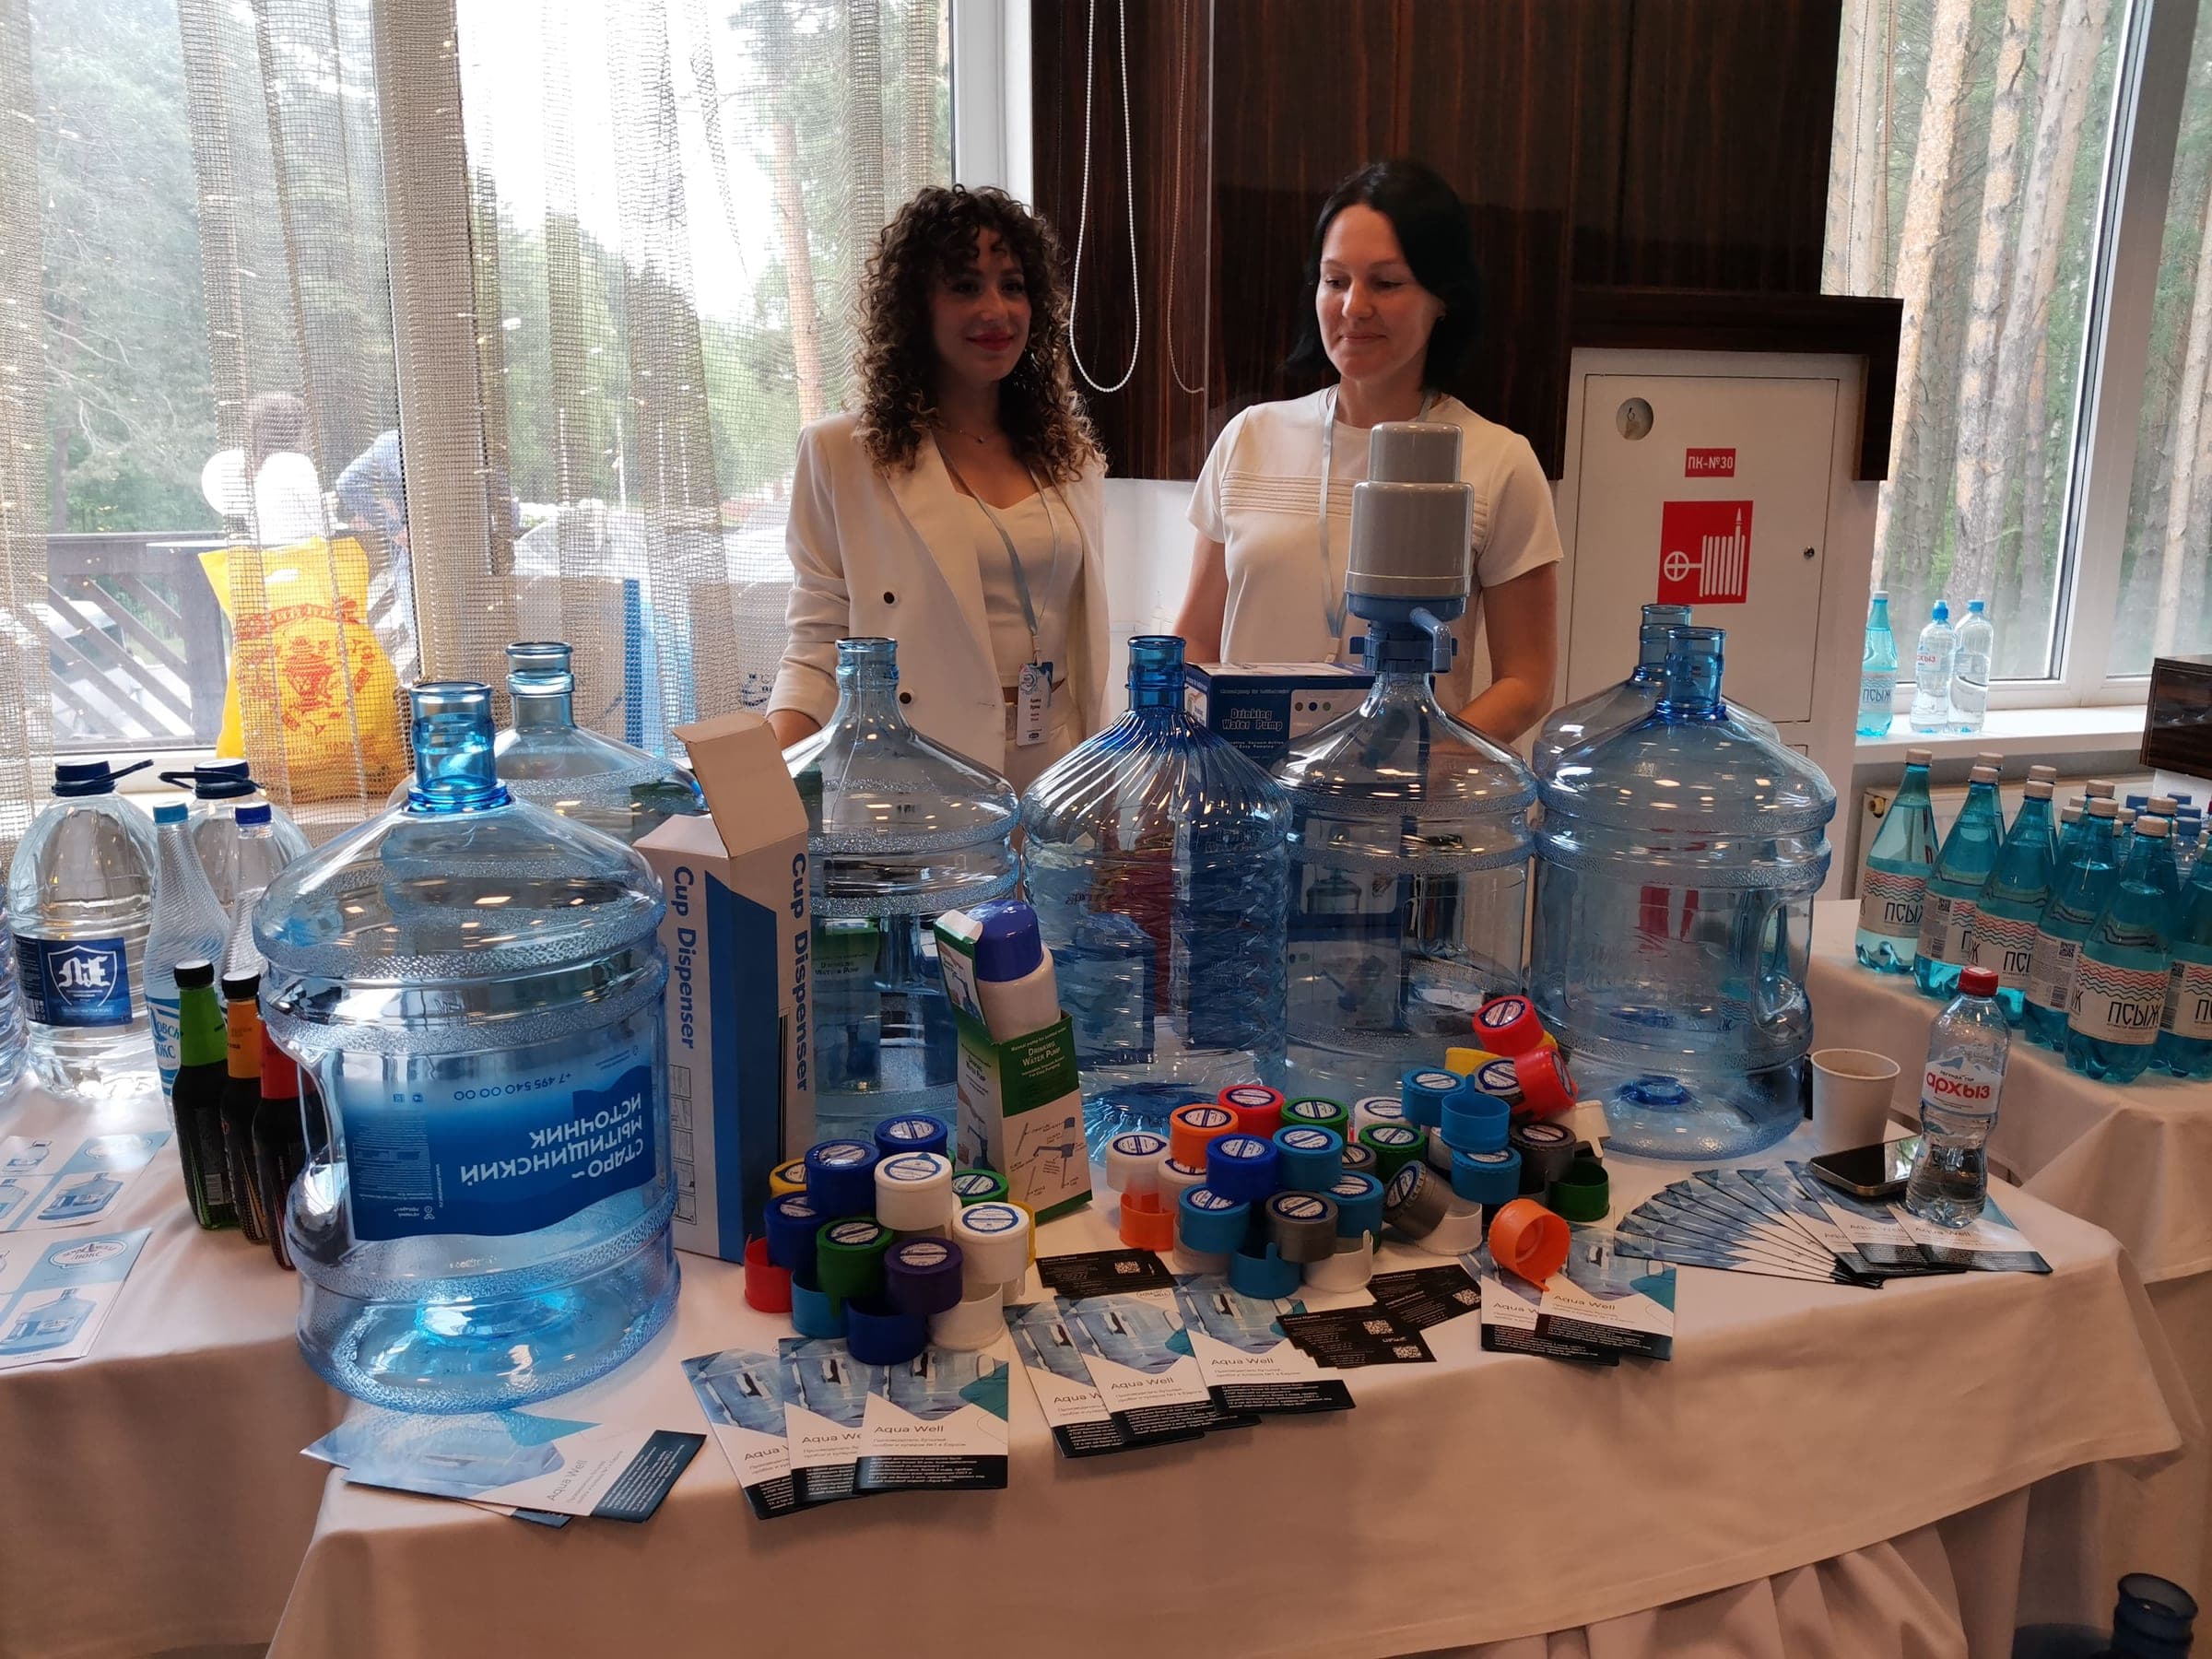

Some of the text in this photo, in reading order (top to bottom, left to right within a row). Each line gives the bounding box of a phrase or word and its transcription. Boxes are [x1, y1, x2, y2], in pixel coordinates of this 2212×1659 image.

[1688, 455, 1734, 470] ПК-№30
[1230, 708, 1273, 721] Drinking
[1222, 720, 1283, 731] Water Pump
[671, 865, 696, 1049] Cup Dispenser
[2004, 951, 2031, 973] ПС
[791, 853, 807, 1090] Cup Dispenser
[2107, 1001, 2161, 1027] ПСЫЖ
[534, 1075, 557, 1088] 495
[529, 1093, 641, 1149] ИСТОЧНИК
[460, 1115, 642, 1186] МЫТИЩИНСКИЙ
[1553, 1295, 1615, 1311] Aqua Well
[1211, 1357, 1243, 1366] Aqua
[1111, 1377, 1174, 1390] Aqua Well
[1053, 1394, 1087, 1404] Aqua
[874, 1425, 945, 1434] Aqua Well
[802, 1435, 838, 1444] Aqua
[744, 1448, 781, 1462] Aqua
[546, 1459, 588, 1501] Aqua Well
